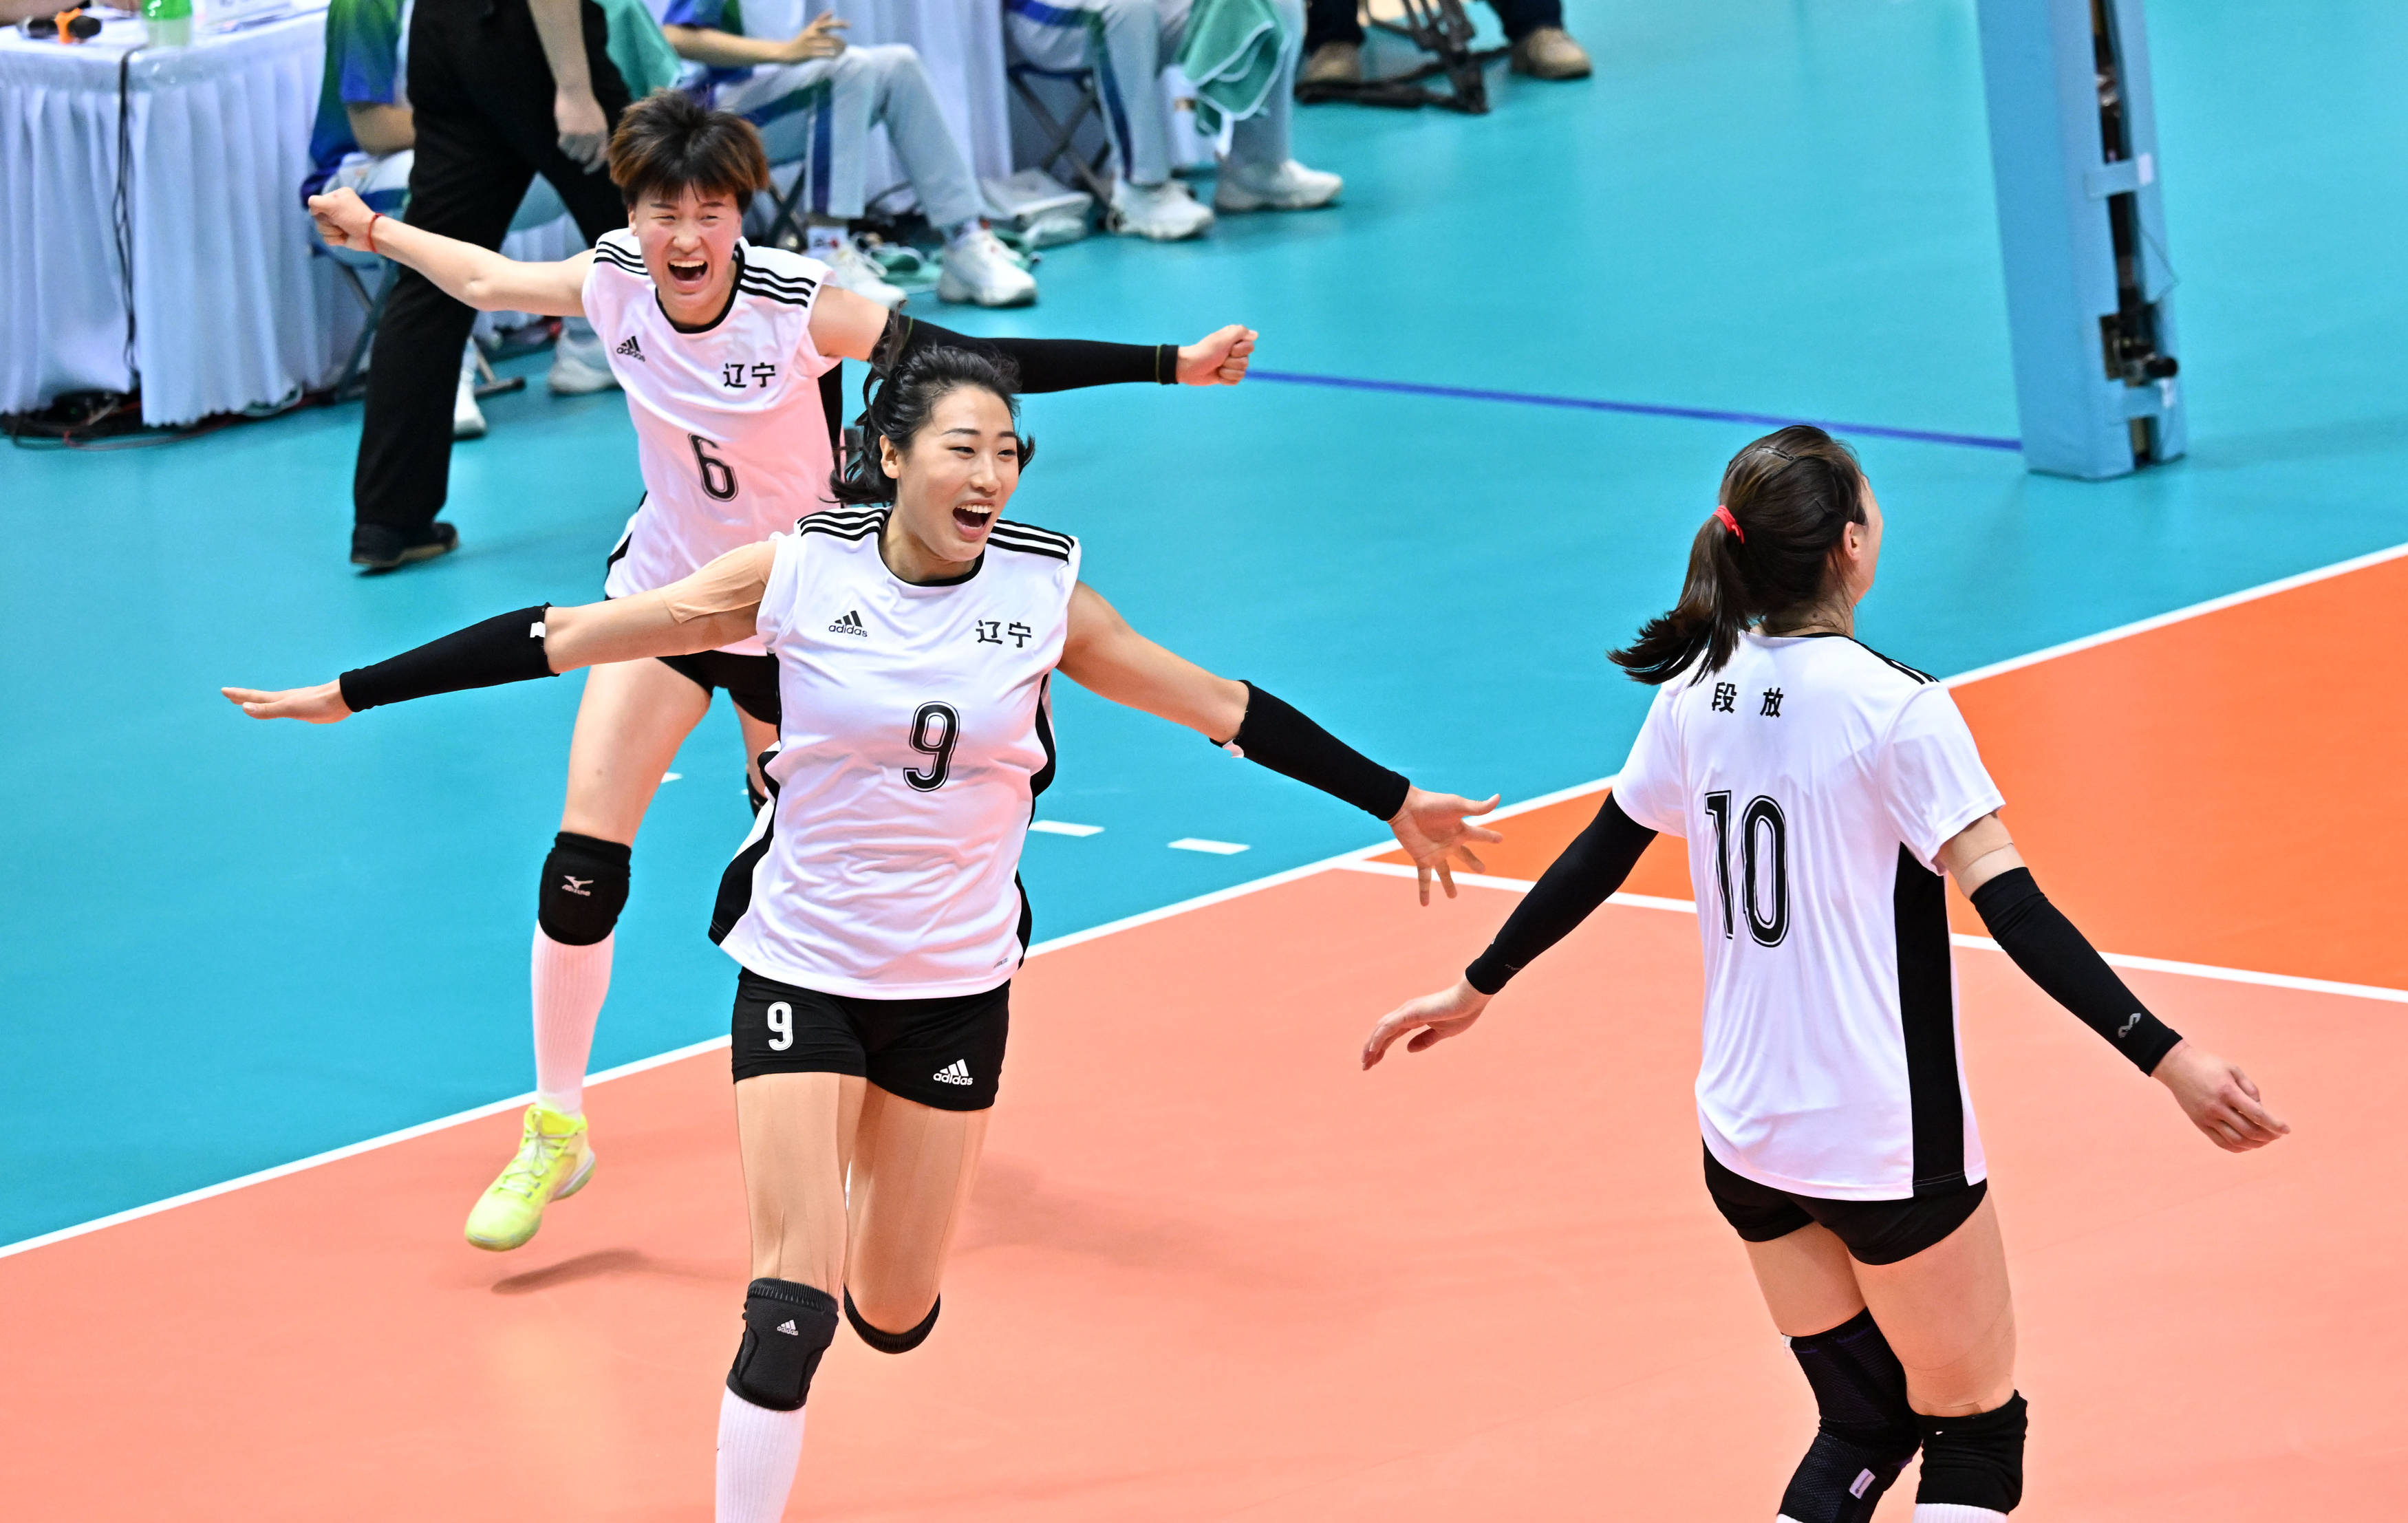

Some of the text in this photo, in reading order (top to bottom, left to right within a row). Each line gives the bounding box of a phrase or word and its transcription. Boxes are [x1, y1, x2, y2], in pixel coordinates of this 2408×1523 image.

[722, 362, 776, 388] 辽宁
[687, 433, 738, 502] 6
[828, 624, 868, 637] adidas
[976, 620, 1032, 648] 辽宁
[1712, 682, 1784, 717] 段放
[903, 701, 960, 792] 9
[1704, 790, 1789, 948] 10
[767, 1001, 793, 1051] 9
[933, 1072, 974, 1085] adidas
[777, 1326, 799, 1336] adidas
